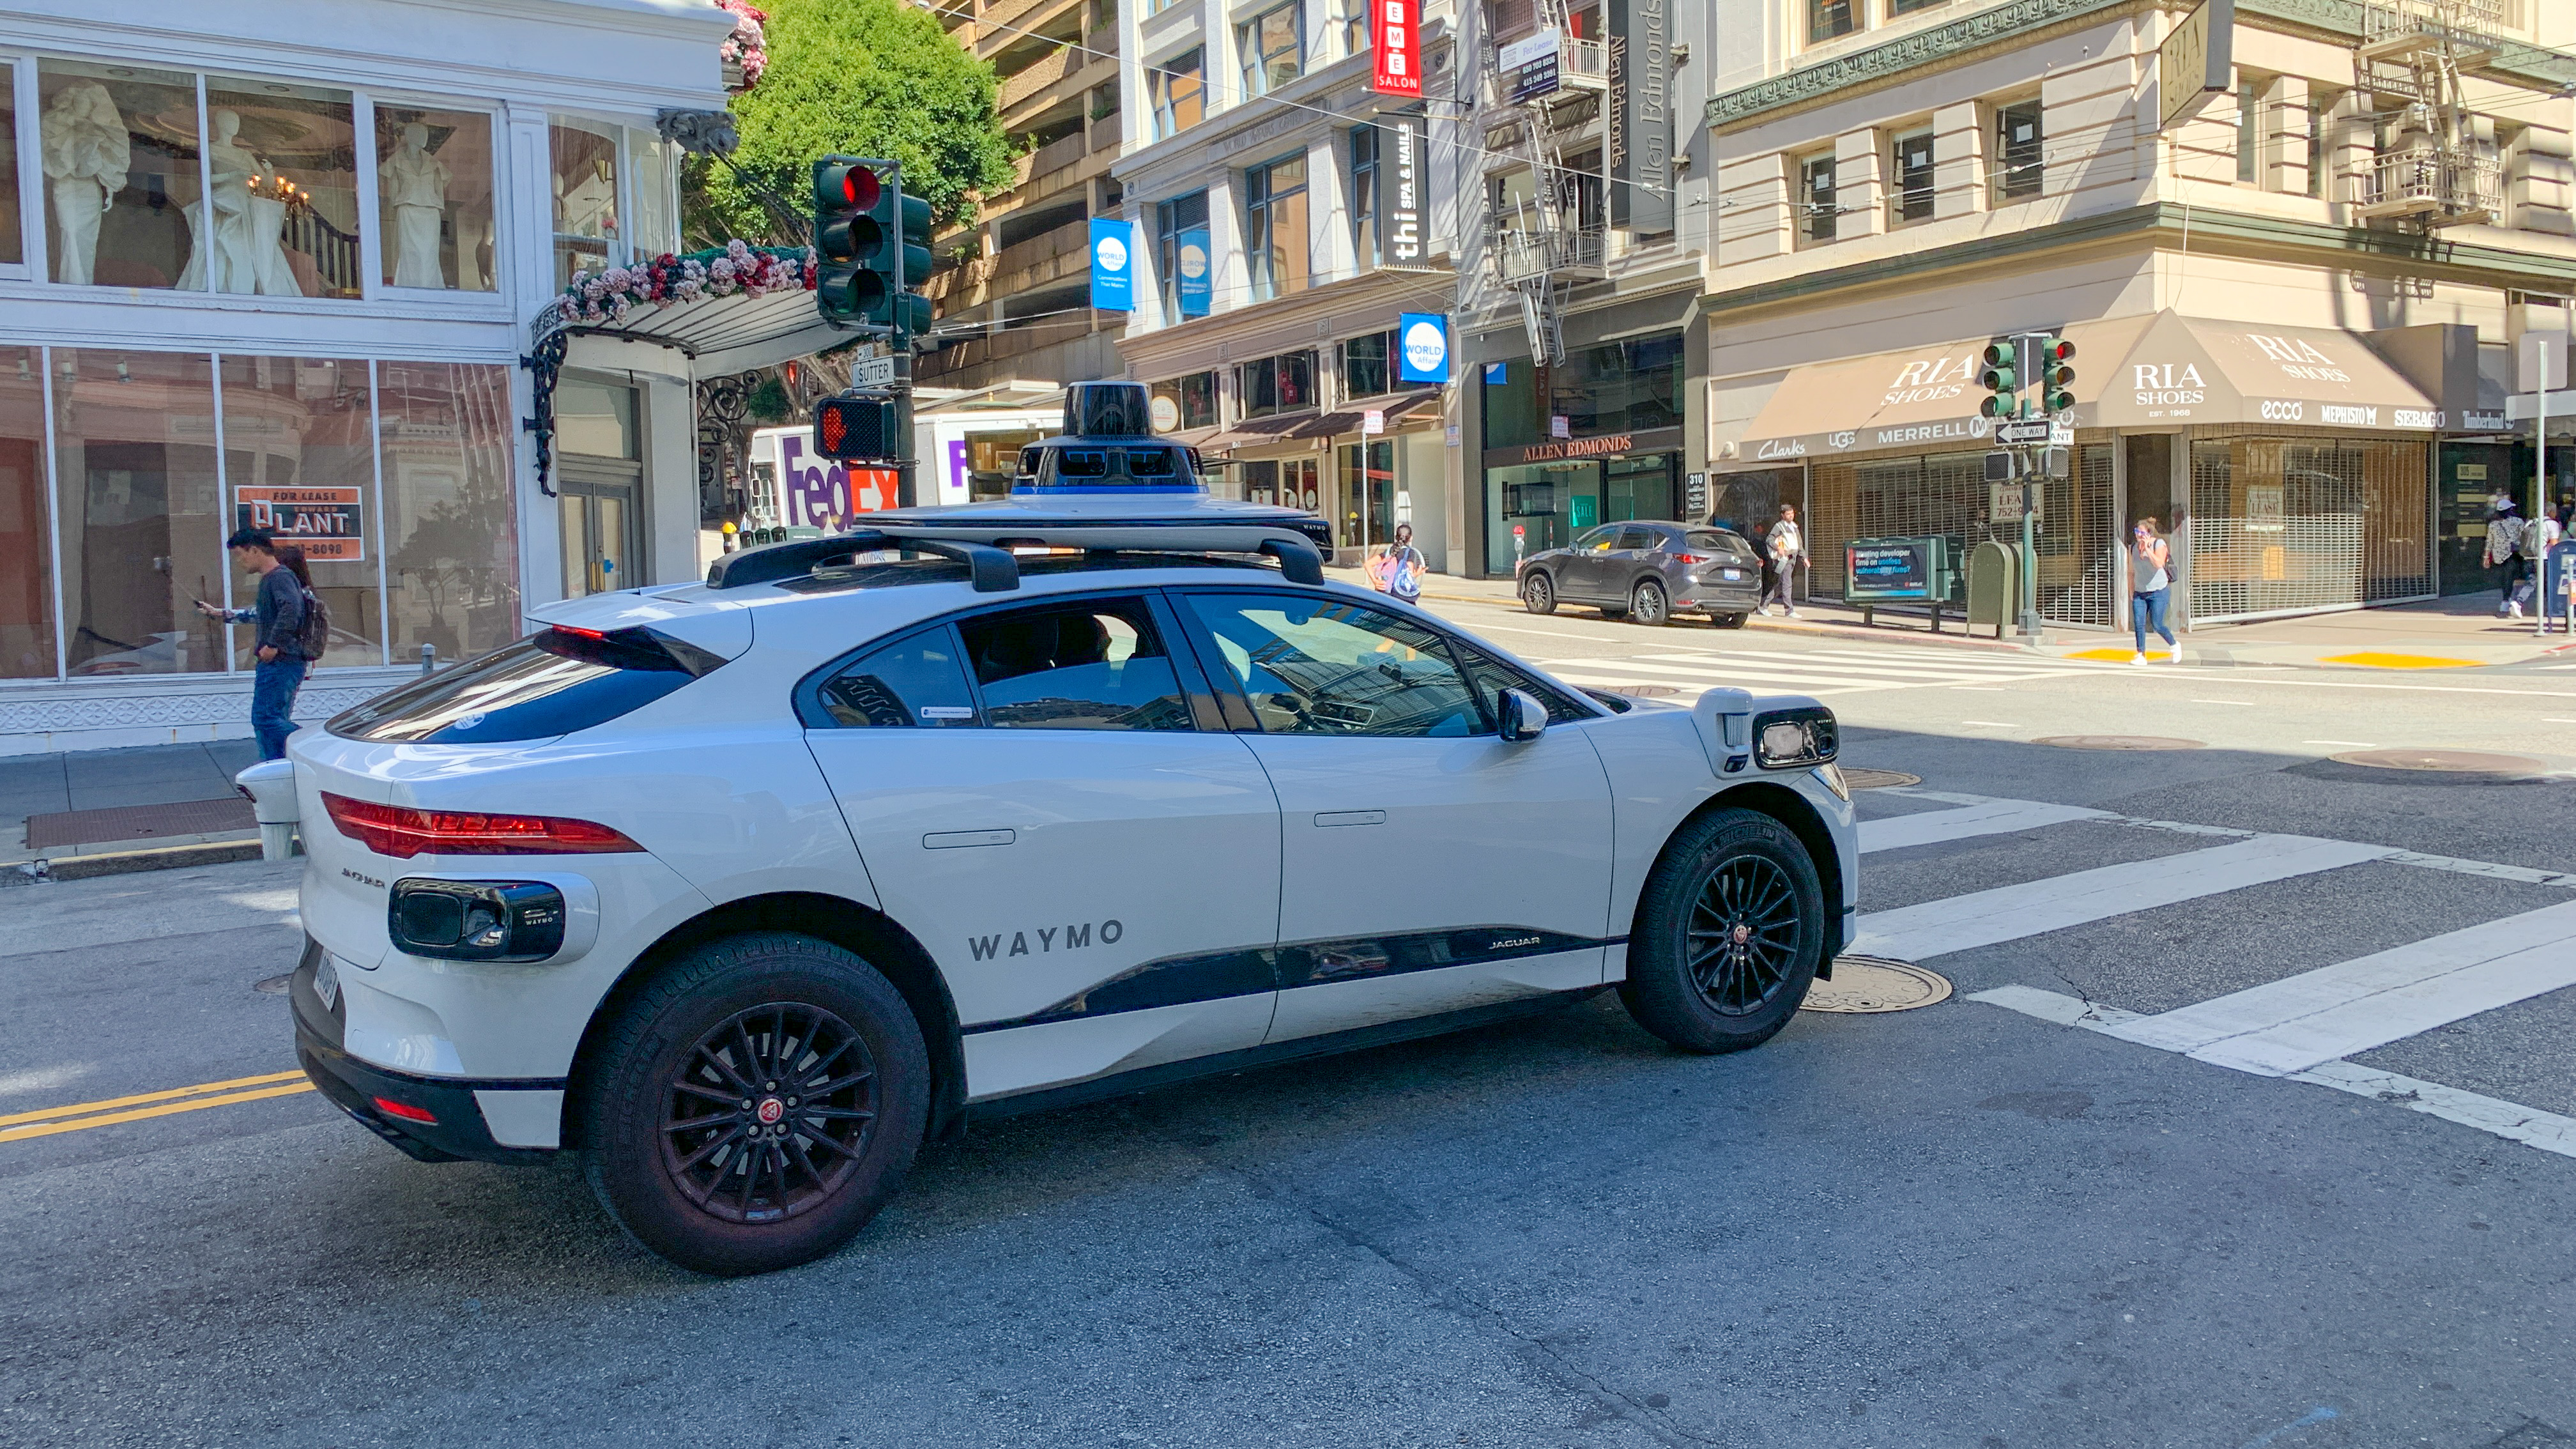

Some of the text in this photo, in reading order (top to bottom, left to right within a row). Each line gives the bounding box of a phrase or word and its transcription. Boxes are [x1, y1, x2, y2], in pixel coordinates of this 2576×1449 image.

[1522, 40, 1553, 56] For Lease
[2168, 19, 2201, 86] RIA
[1379, 75, 1418, 89] SALON
[2169, 65, 2200, 111] SHOES
[1610, 34, 1627, 169] Allen Edmonds
[1637, 0, 1665, 203] Allen Edmonds
[1279, 111, 1304, 128] CENTER
[1398, 123, 1411, 165] NAILS
[1399, 169, 1411, 180] &
[1400, 182, 1413, 209] SPA
[1099, 252, 1124, 261] WORLD
[1407, 344, 1441, 356] WORLD
[2246, 334, 2335, 365] RIA
[1417, 356, 1442, 365] Affairs
[859, 363, 889, 383] SUTTER
[1889, 354, 1974, 389] RIA
[2133, 362, 2207, 390] RIA
[2281, 364, 2351, 383] SHOES
[1880, 383, 1965, 406] SHOES
[2136, 390, 2204, 406] SHOES
[2170, 409, 2191, 417] 1968
[2261, 400, 2303, 421] ecco
[2321, 405, 2365, 425] MEPHISTO
[2394, 410, 2446, 428] SEBAGO
[2462, 410, 2504, 430] Timberland
[2028, 427, 2044, 436] WAY
[2050, 433, 2071, 441] ANT
[1523, 435, 1632, 462] ALLEN EDMONDS
[1758, 439, 1805, 460] Clarks
[1828, 431, 1855, 448] UGG
[1878, 422, 1968, 444] MERRELL
[783, 436, 900, 532] FedEx
[1689, 473, 1703, 485] 310
[273, 492, 337, 500] FOR LEASE
[1576, 505, 1592, 518] SALE
[1880, 549, 1910, 558] developer
[526, 917, 553, 925] WAYMO
[969, 919, 1123, 962] WAYMO
[1488, 937, 1540, 949] JAGUAR
